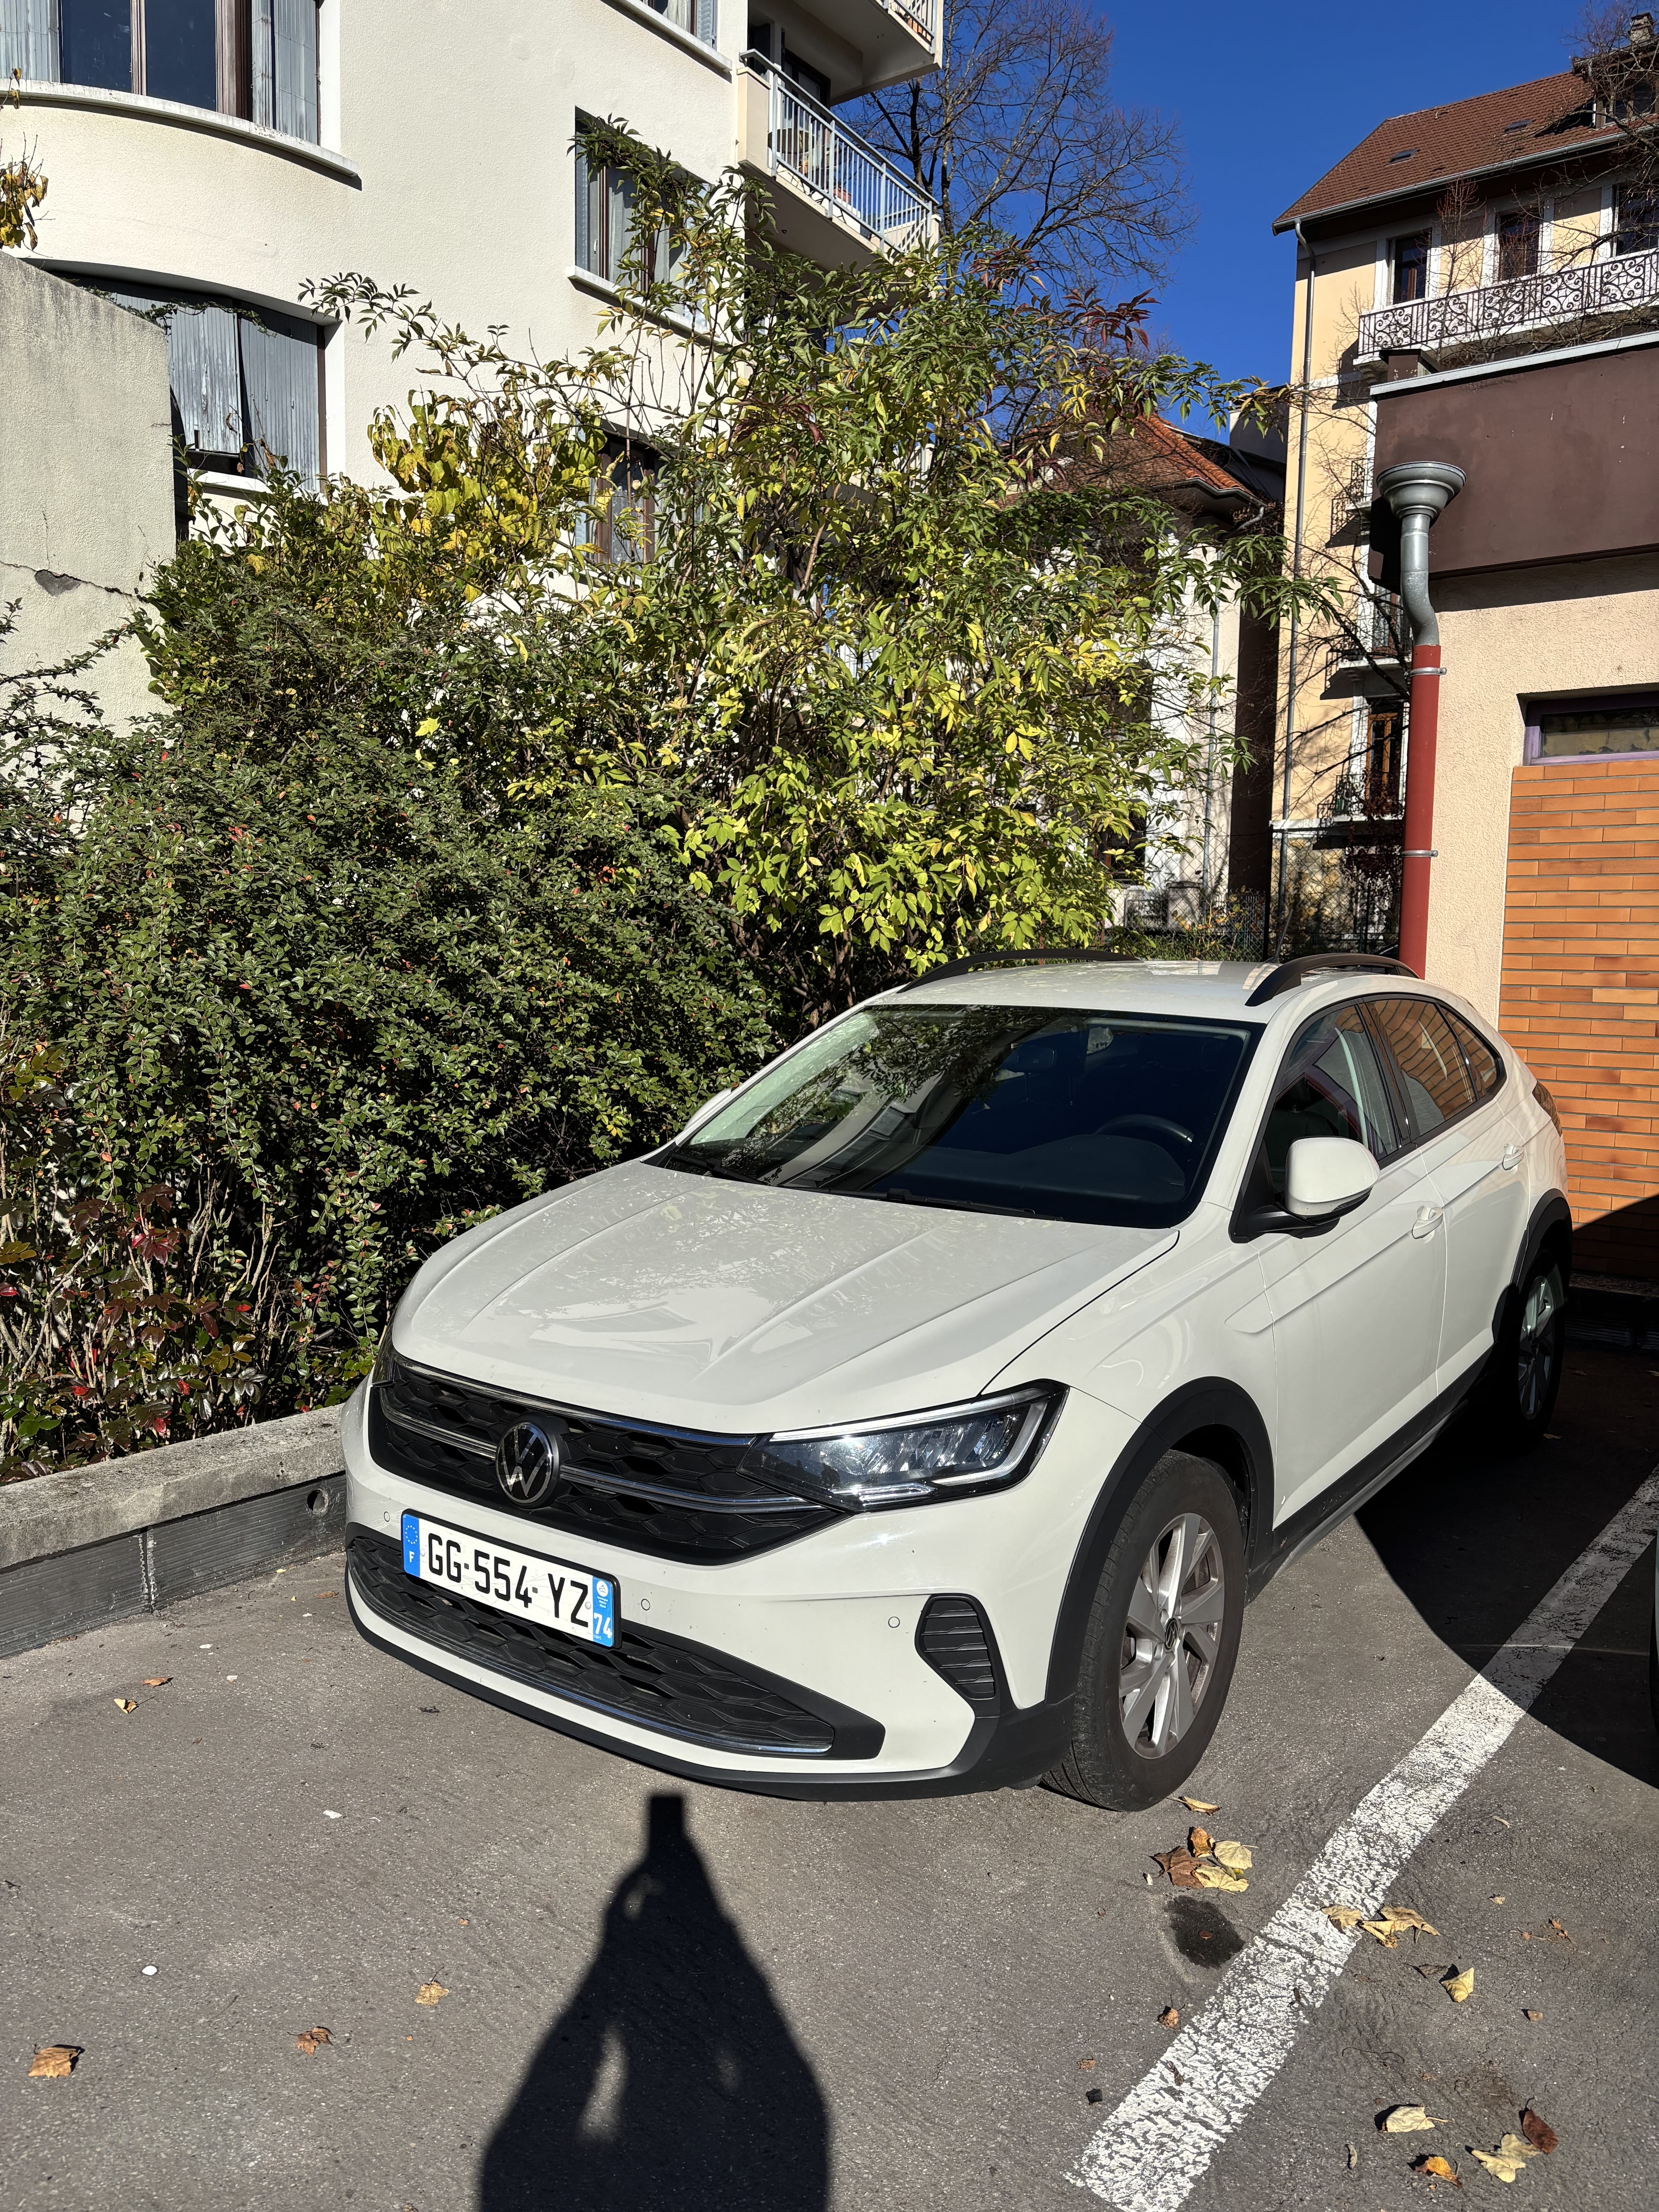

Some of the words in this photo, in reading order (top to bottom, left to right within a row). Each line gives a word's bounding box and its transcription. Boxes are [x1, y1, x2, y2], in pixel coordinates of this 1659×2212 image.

[500, 1424, 550, 1499] VW
[409, 1551, 415, 1563] F
[428, 1533, 589, 1628] GG-554-YZ
[594, 1612, 612, 1639] 74
